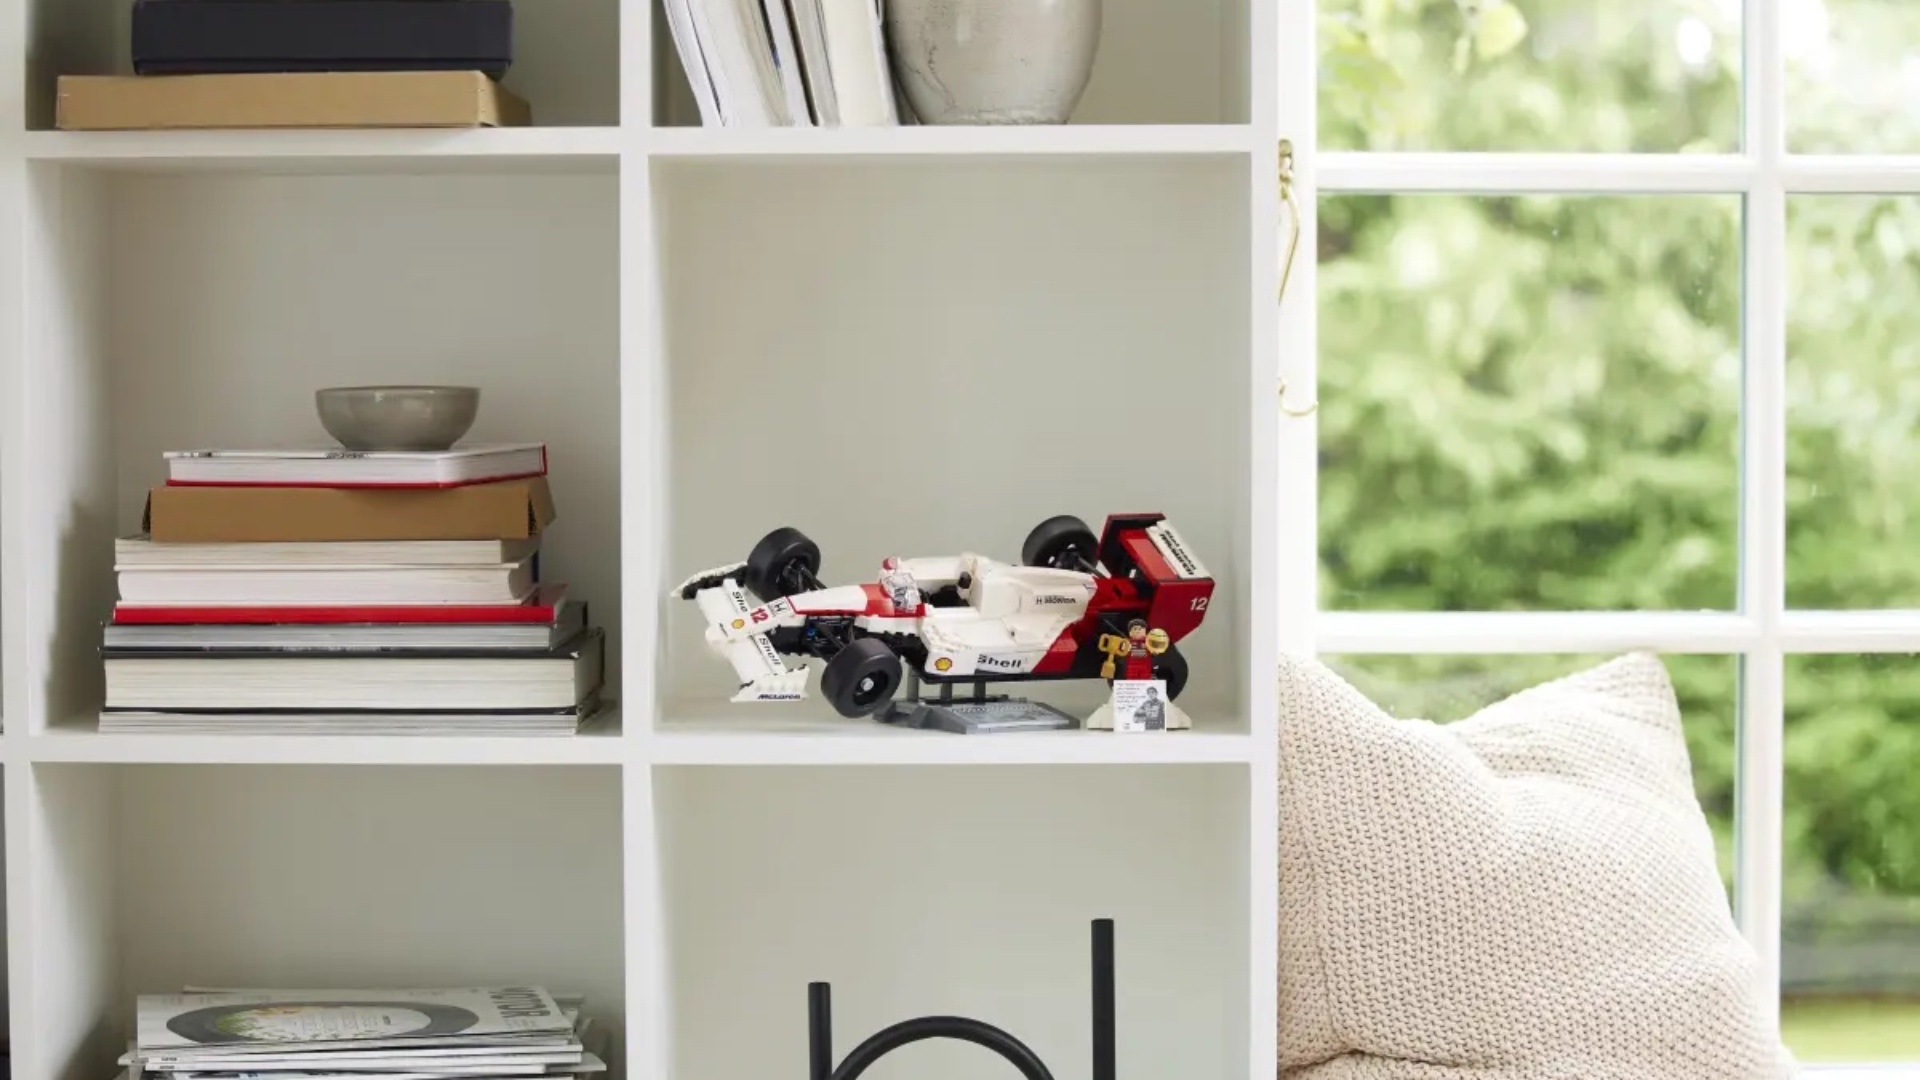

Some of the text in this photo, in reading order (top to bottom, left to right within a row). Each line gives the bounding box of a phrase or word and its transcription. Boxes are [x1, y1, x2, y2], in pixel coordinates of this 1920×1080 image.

[1189, 597, 1207, 611] 12
[750, 607, 769, 624] 12
[758, 637, 782, 665] Shell
[977, 653, 1022, 668] Shell
